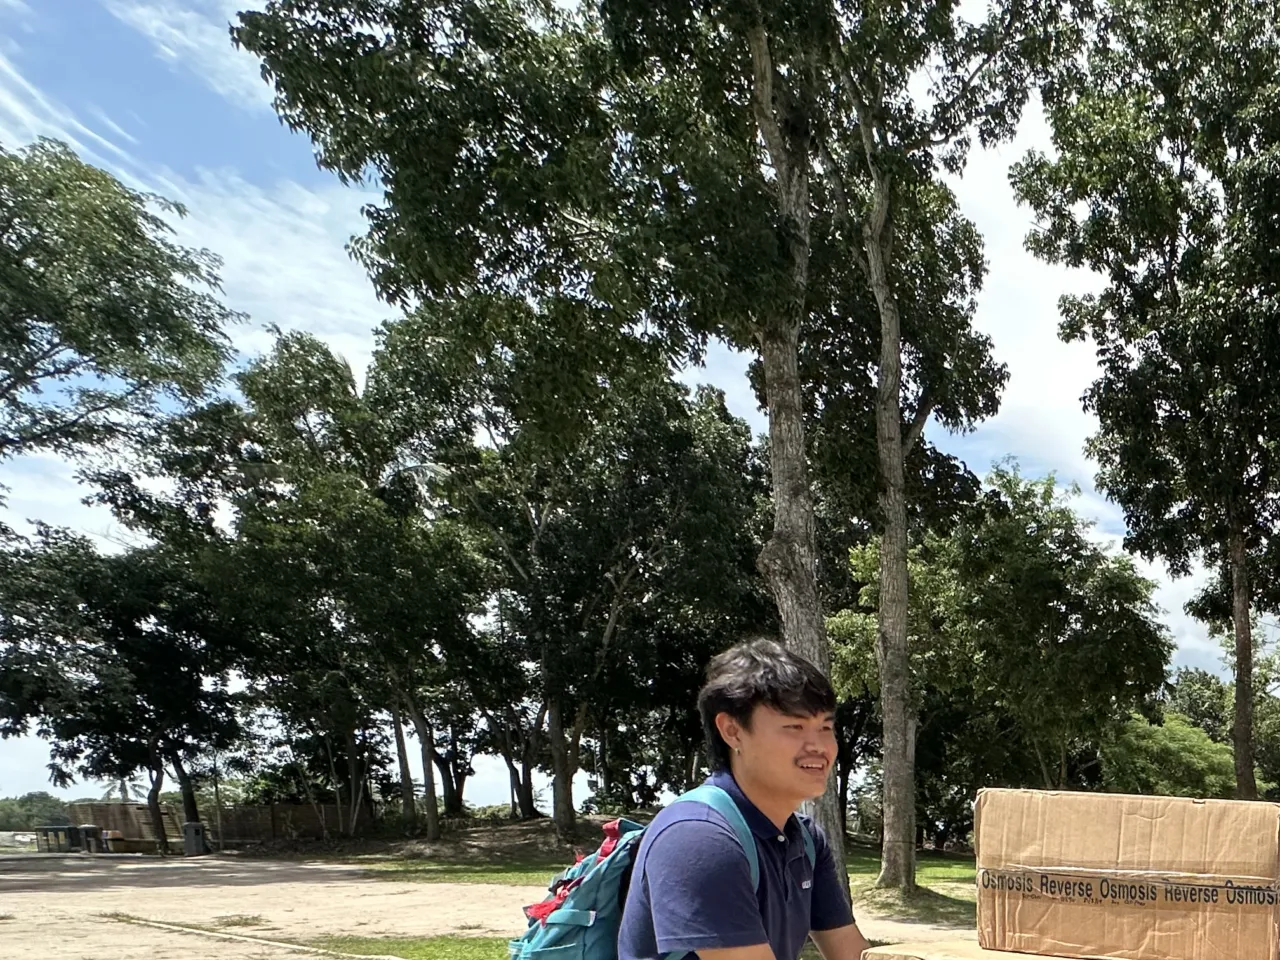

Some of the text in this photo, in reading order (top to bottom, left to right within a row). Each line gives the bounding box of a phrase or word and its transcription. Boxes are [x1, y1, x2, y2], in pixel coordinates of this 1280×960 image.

[982, 870, 1033, 893] Osmosis
[1040, 875, 1093, 898] Reverse
[1100, 878, 1157, 901] Osmosis
[1164, 880, 1219, 903] Reverse
